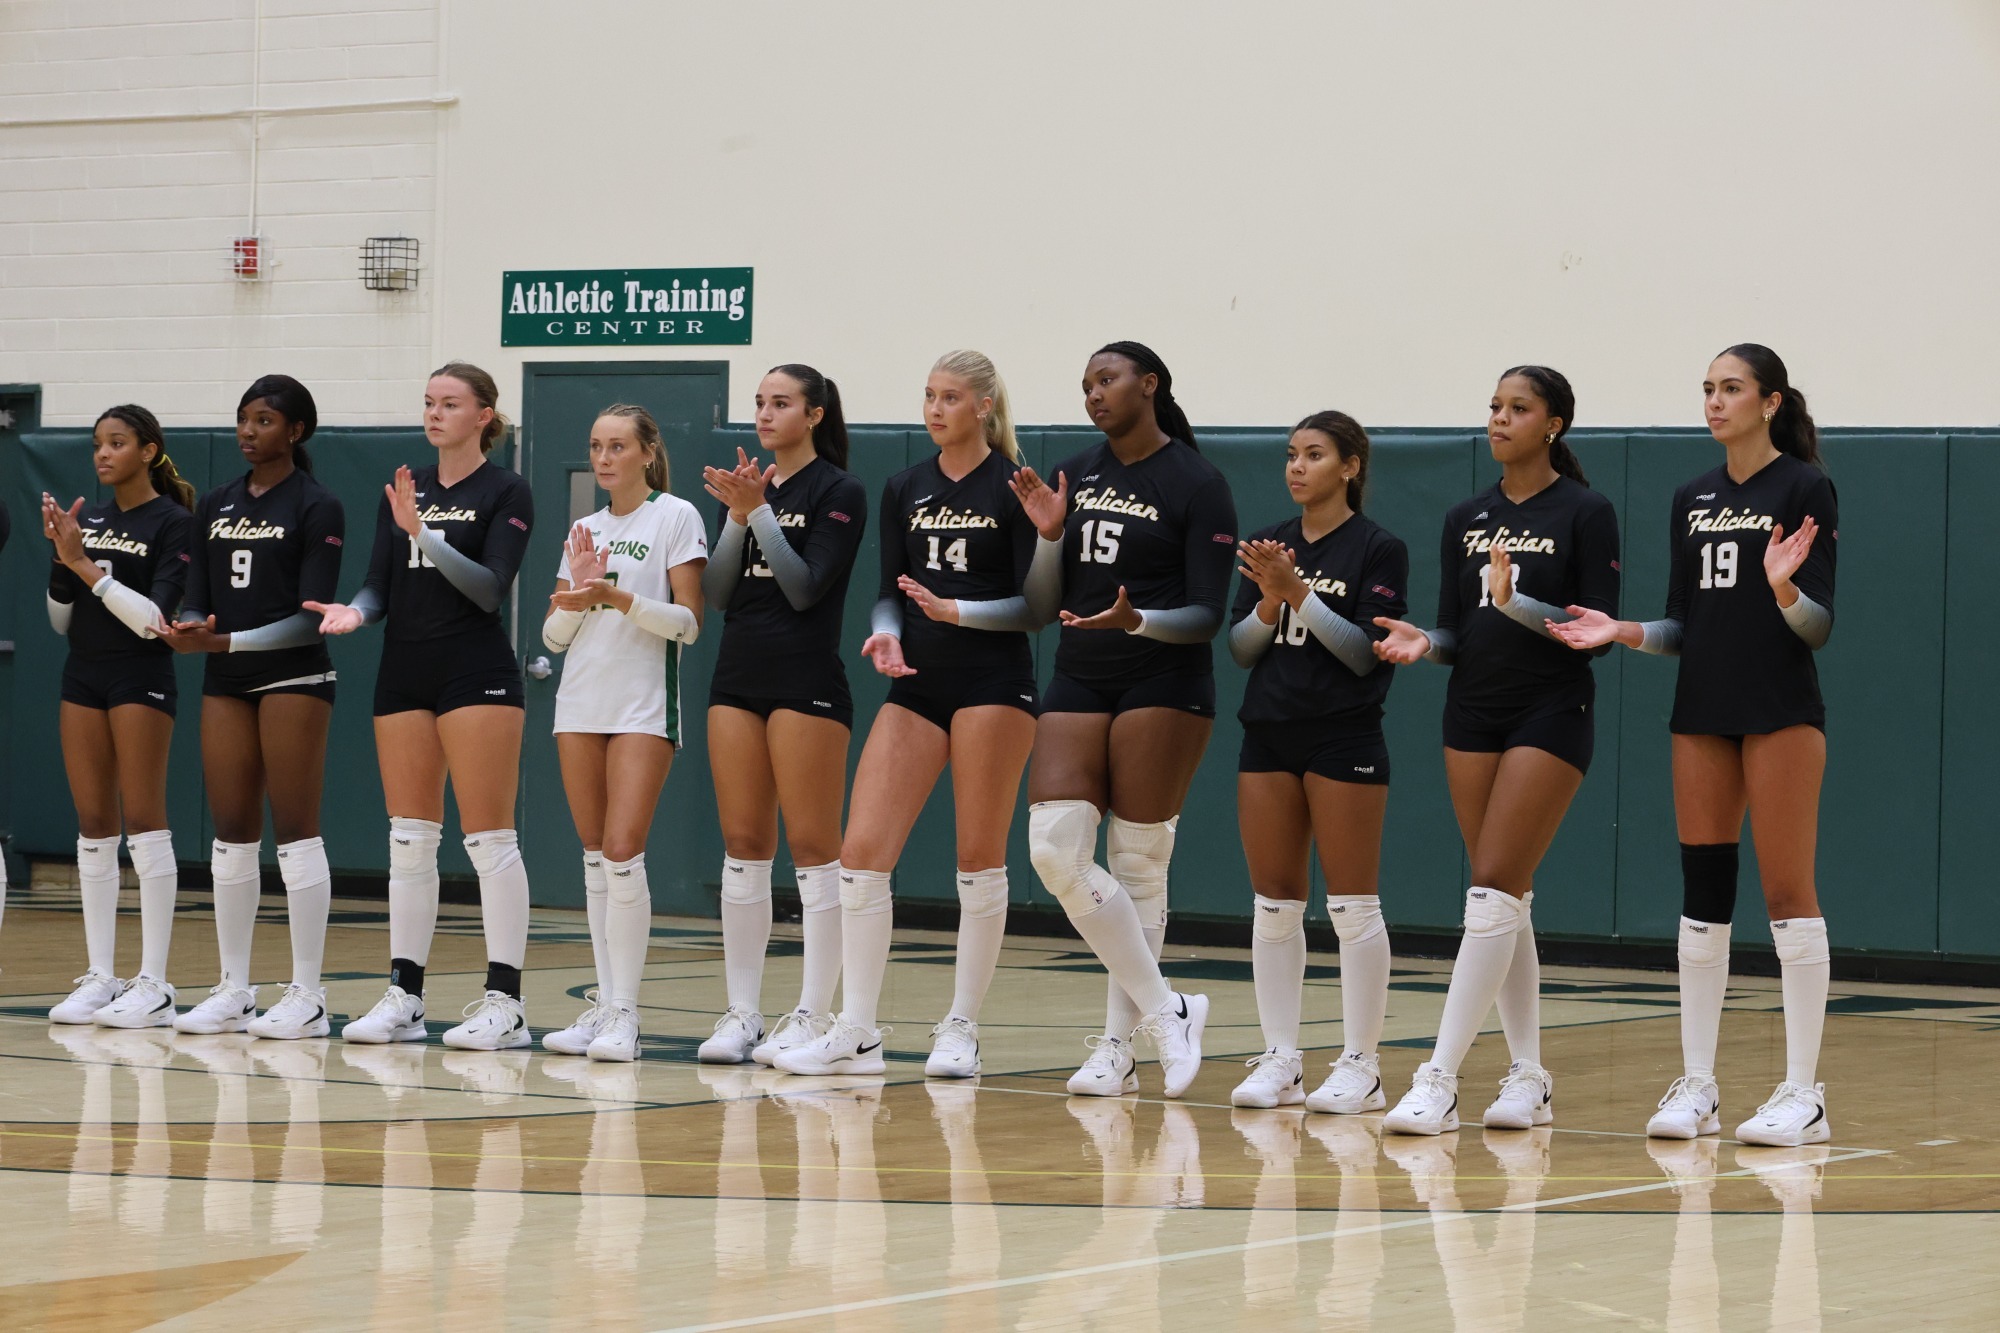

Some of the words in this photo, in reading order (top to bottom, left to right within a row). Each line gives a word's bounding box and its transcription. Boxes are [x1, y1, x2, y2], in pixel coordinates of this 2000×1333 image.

[508, 280, 614, 314] Athletic
[624, 278, 746, 321] Training
[546, 320, 704, 335] CENTER
[908, 506, 998, 532] Felician
[1074, 487, 1159, 522] Felician
[208, 517, 285, 540] Felician
[1687, 507, 1774, 536] Felician
[81, 528, 148, 557] Felician
[926, 536, 968, 572] 14
[1080, 519, 1124, 564] 15
[1462, 526, 1556, 558] Felician
[230, 549, 253, 588] 9
[1699, 541, 1739, 590] 19
